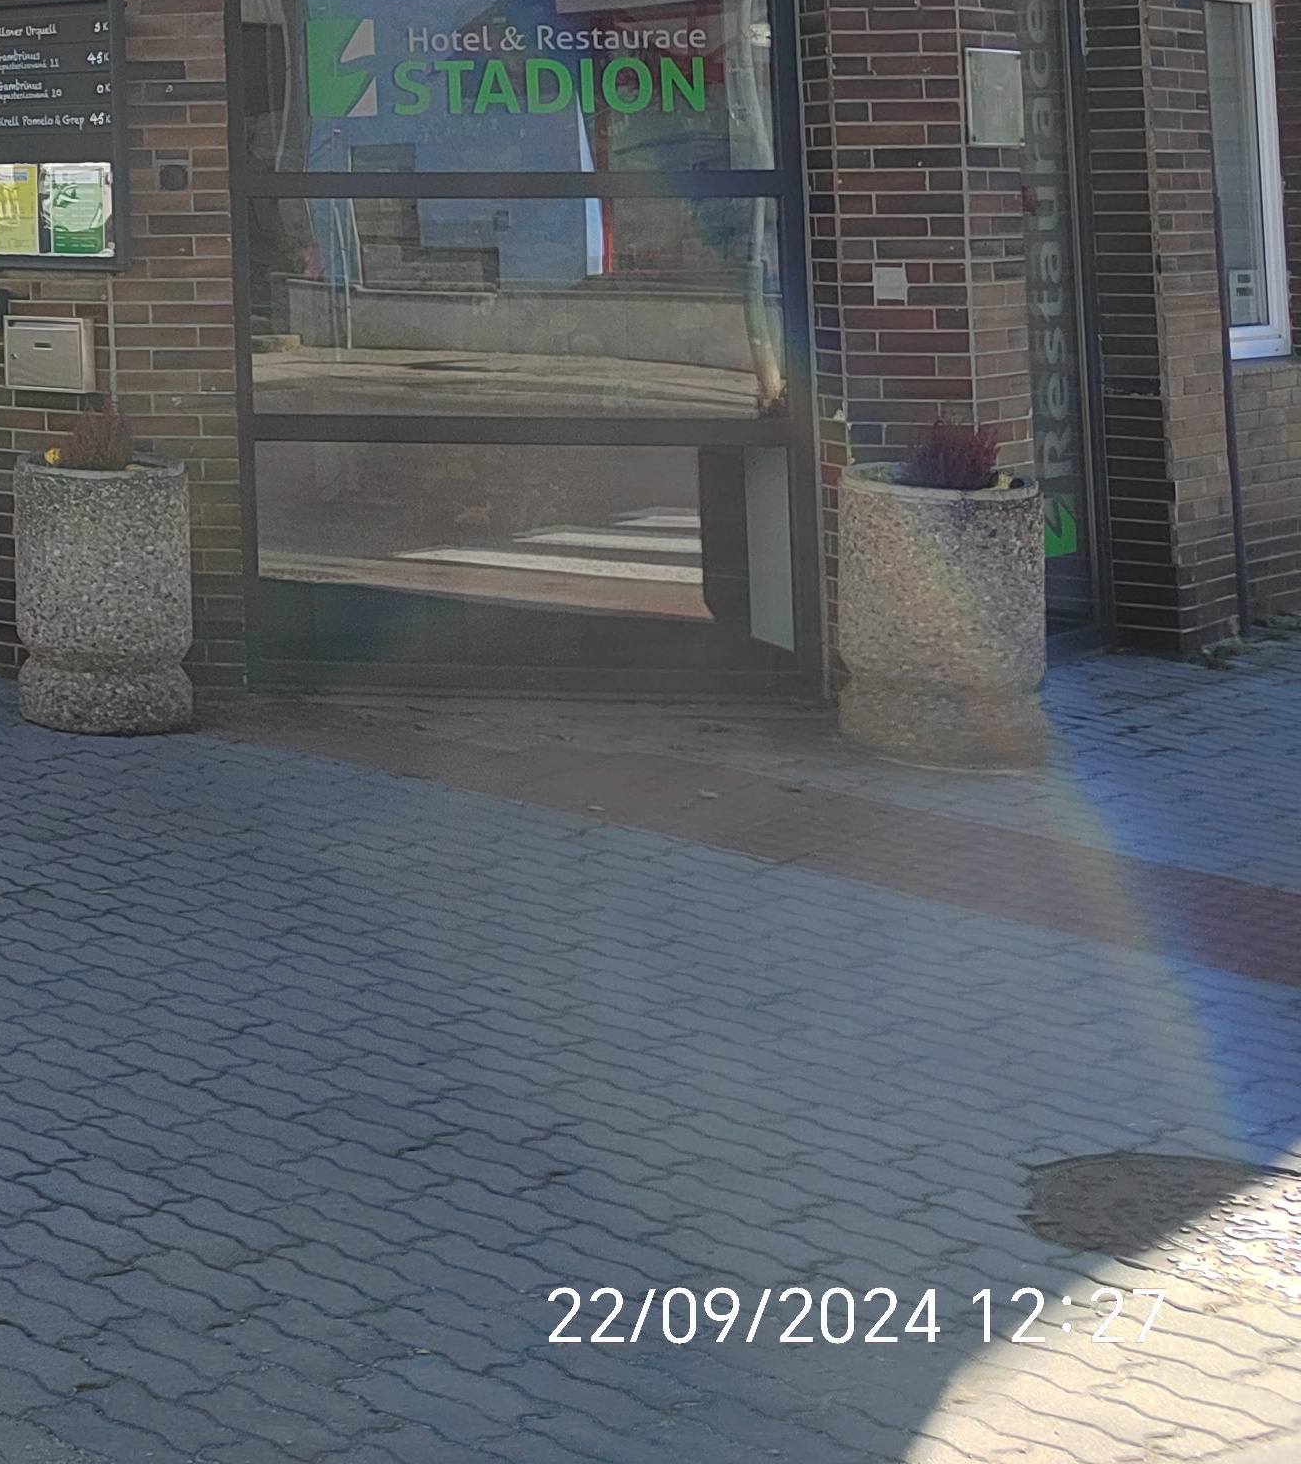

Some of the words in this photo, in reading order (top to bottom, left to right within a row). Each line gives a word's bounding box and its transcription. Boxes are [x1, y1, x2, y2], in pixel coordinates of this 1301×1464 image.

[408, 26, 492, 53] Hotel
[500, 26, 527, 52] &
[536, 25, 707, 51] Restaurace
[394, 57, 707, 115] STADION
